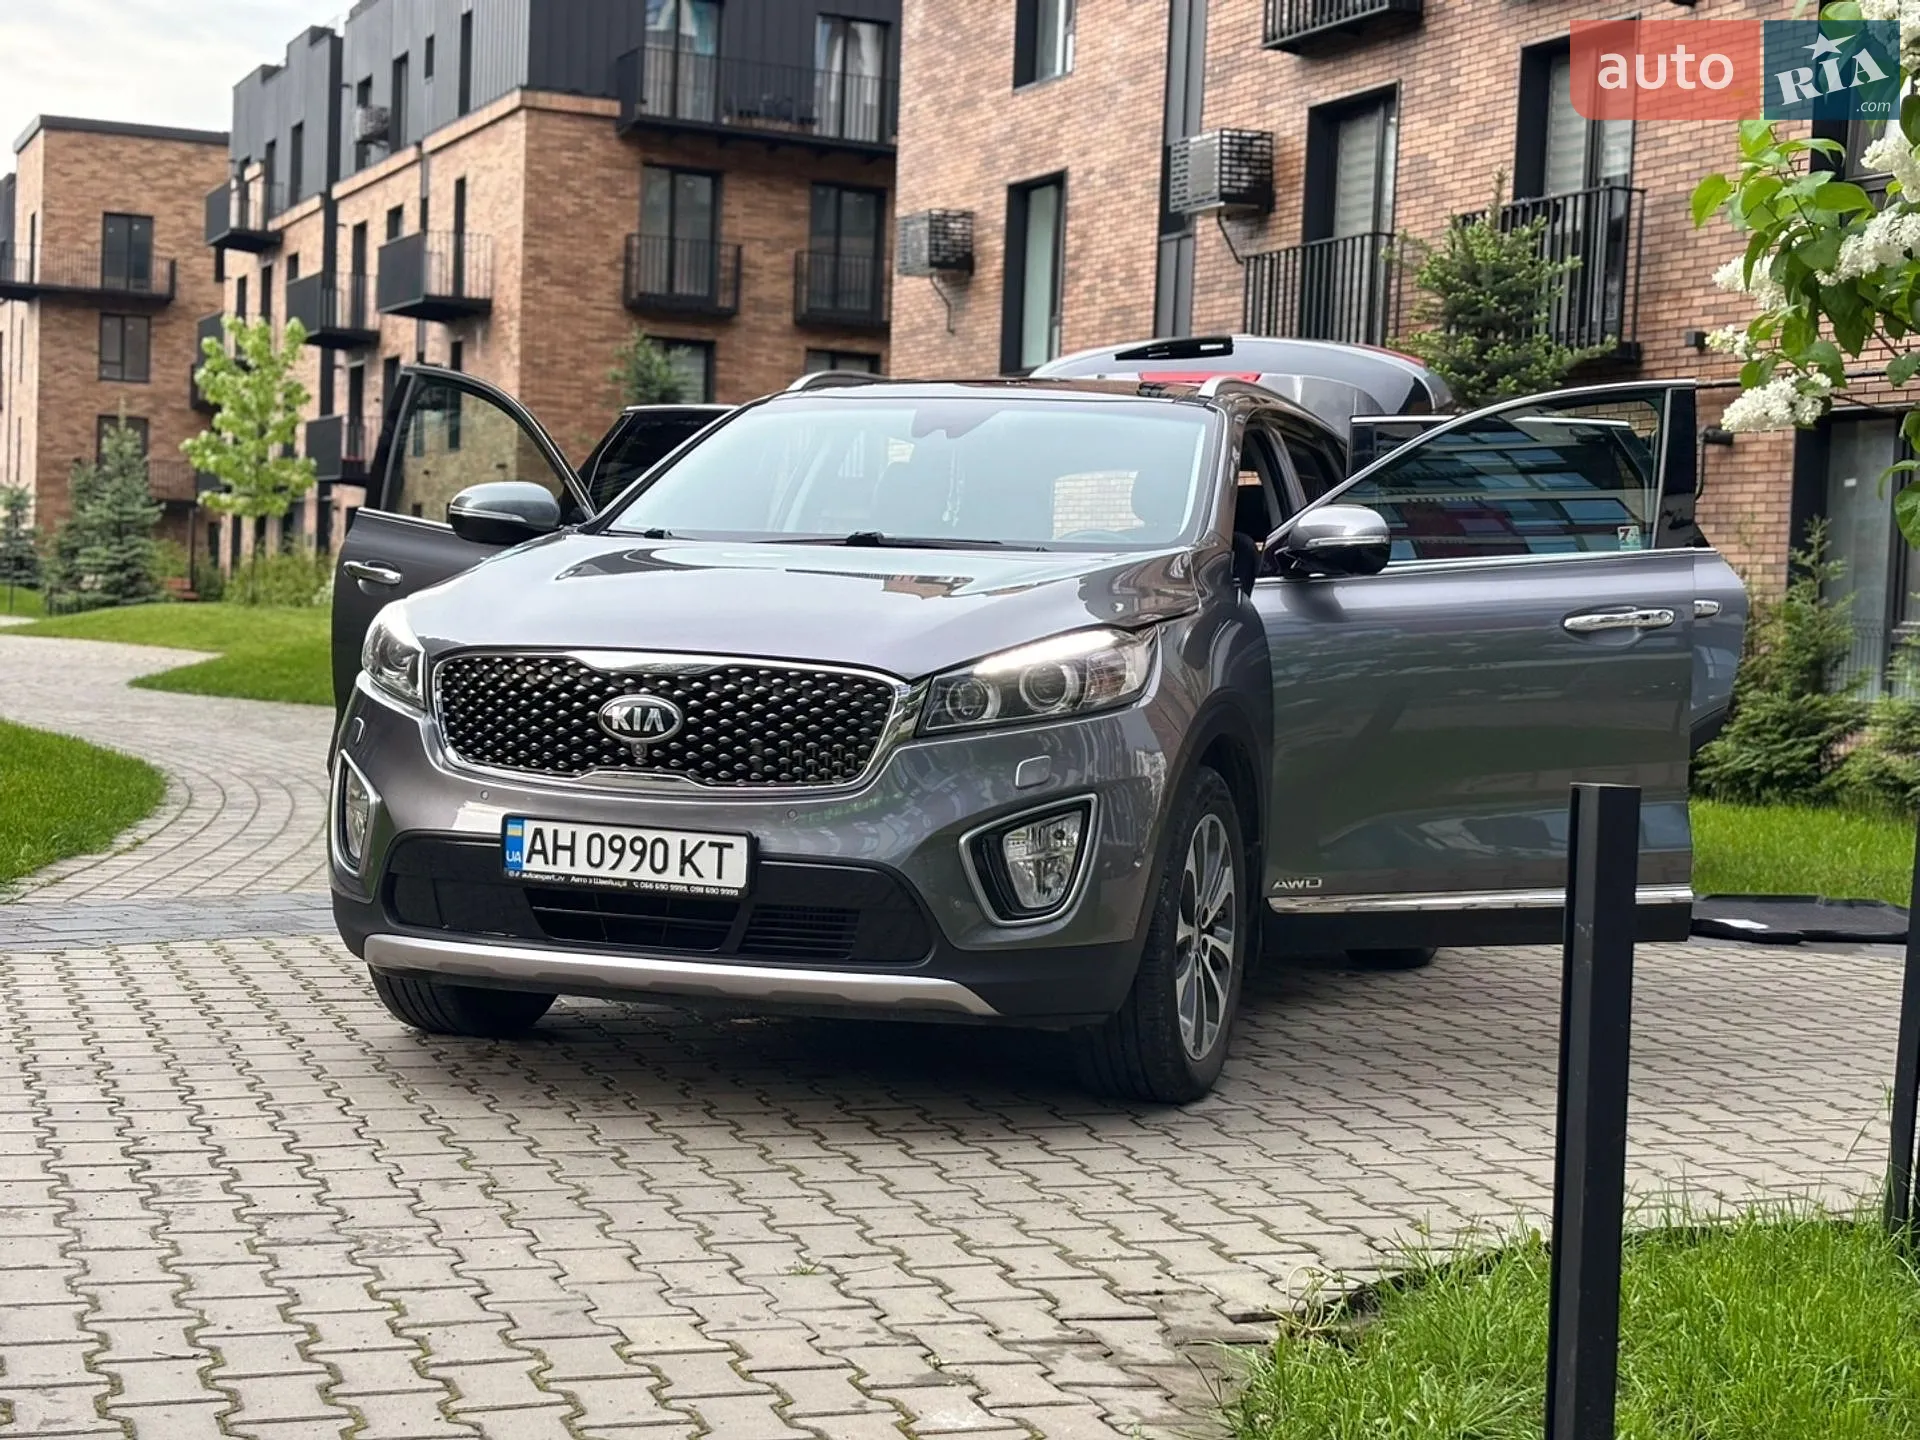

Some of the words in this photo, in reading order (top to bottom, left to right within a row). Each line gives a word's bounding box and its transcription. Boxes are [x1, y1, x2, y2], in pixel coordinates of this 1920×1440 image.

[611, 705, 666, 732] KIA
[506, 850, 522, 863] UA
[526, 827, 576, 868] AH
[586, 832, 669, 875] 0990
[679, 838, 734, 880] KT
[1272, 876, 1323, 890] AWD
